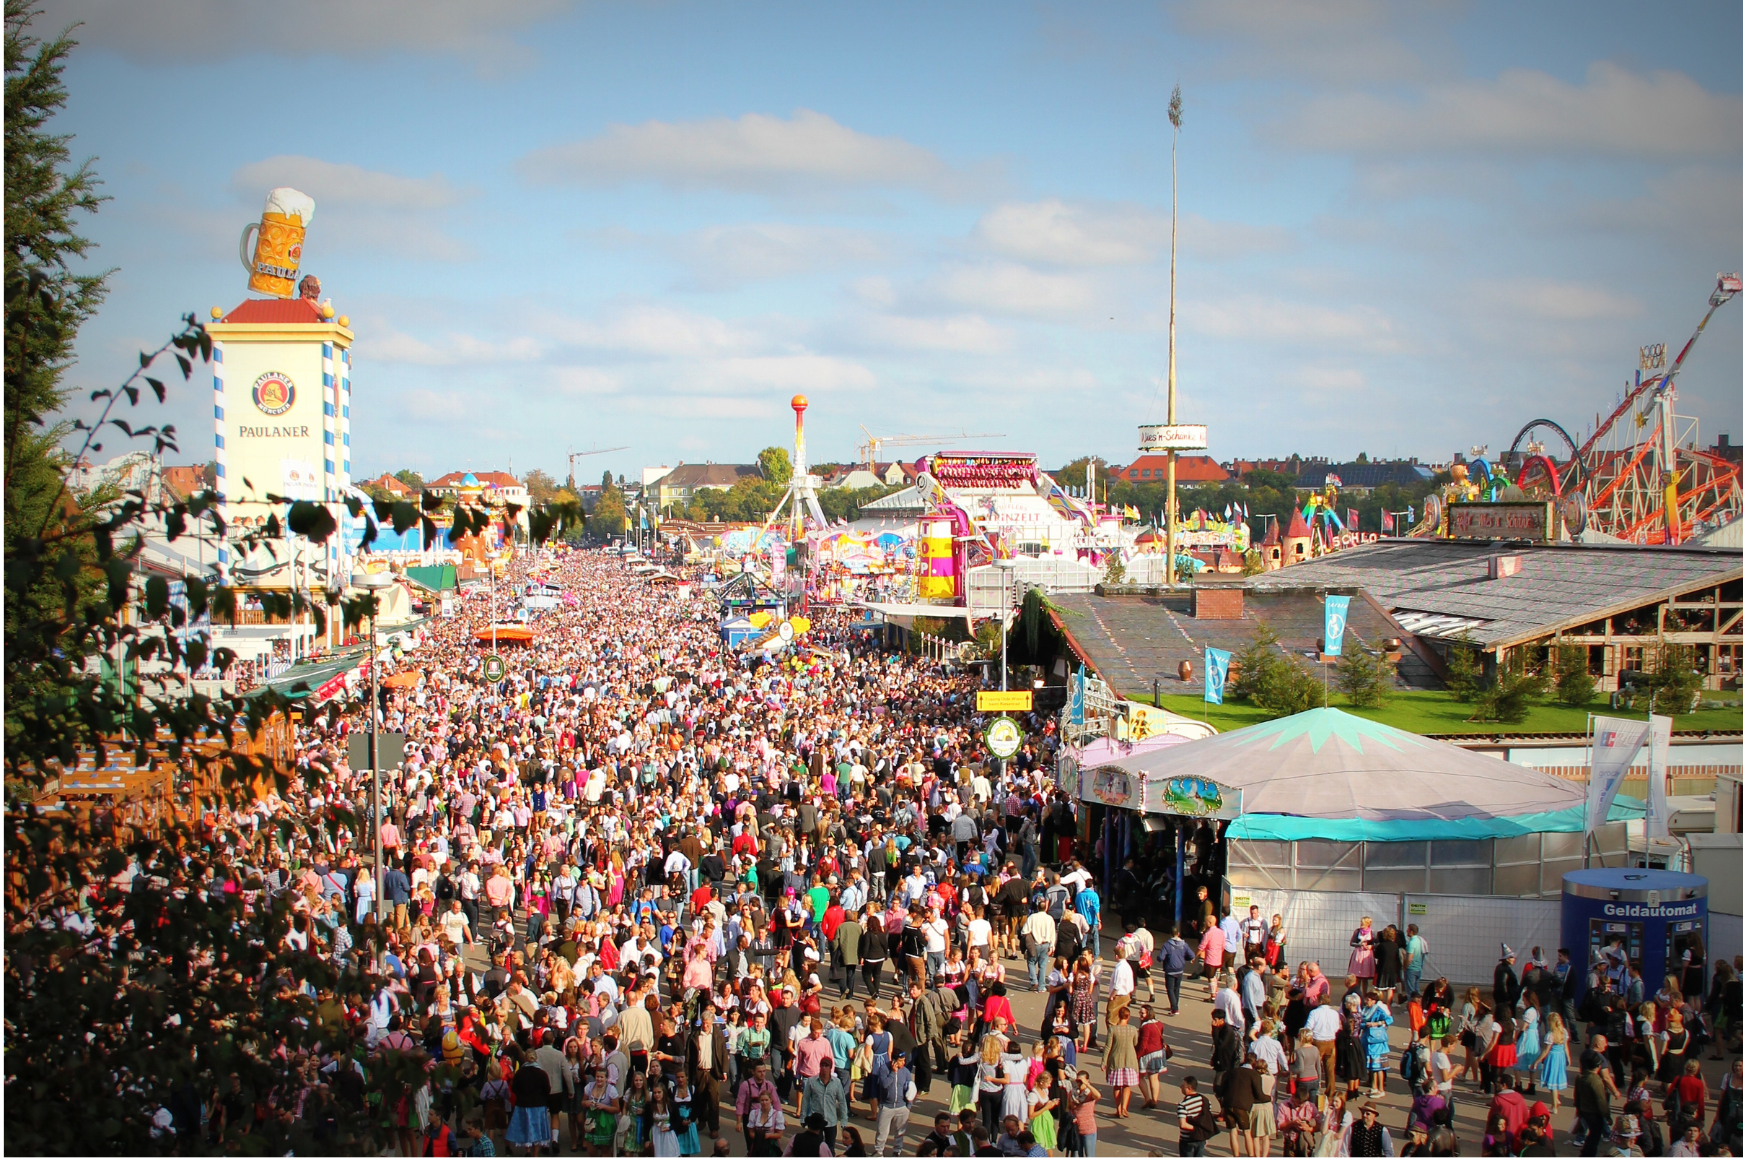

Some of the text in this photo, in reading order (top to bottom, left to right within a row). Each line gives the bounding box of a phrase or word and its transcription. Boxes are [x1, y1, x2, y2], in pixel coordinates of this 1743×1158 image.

[253, 371, 293, 389] PAULANER
[257, 402, 291, 415] MÜNCHEN
[239, 425, 310, 437] PAULANER
[1604, 903, 1697, 917] Geldautomat
